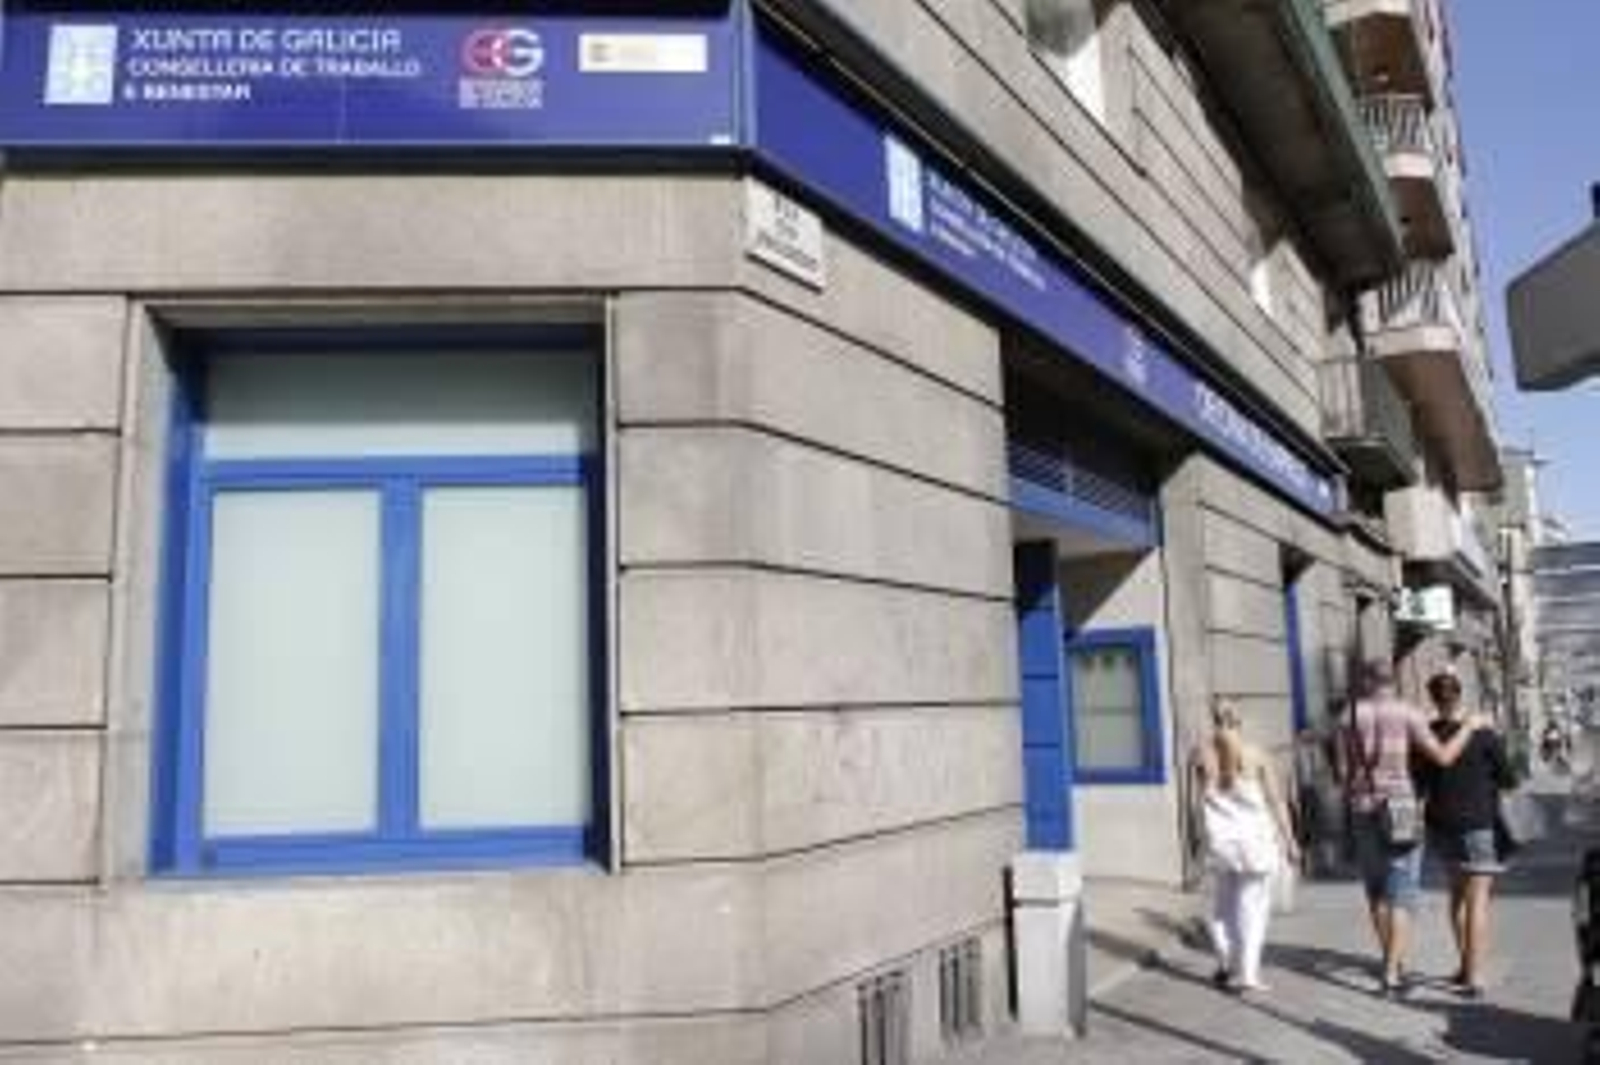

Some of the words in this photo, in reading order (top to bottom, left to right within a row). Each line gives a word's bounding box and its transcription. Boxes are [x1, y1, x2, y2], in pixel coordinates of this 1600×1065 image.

[132, 29, 232, 51] XUNTA
[240, 29, 276, 51] DE
[281, 28, 401, 52] GALICIA
[280, 58, 306, 77] DE
[311, 58, 421, 77] TRABALLO
